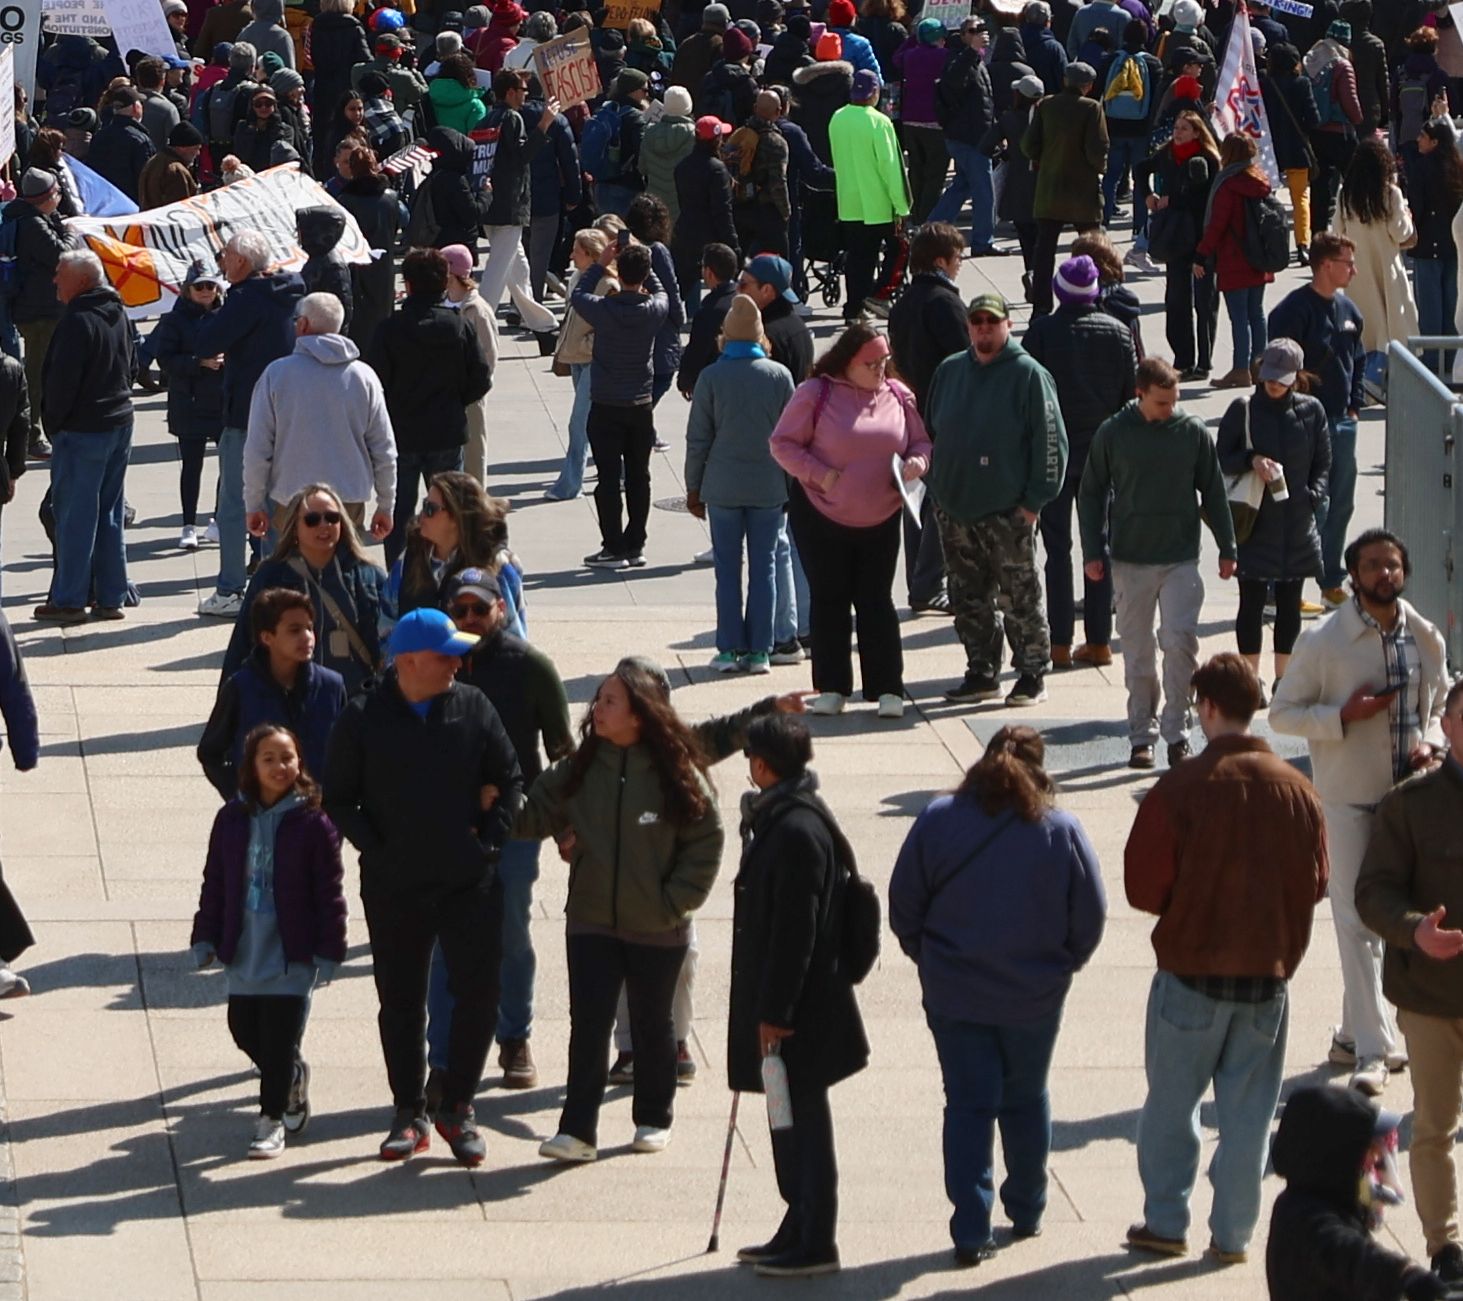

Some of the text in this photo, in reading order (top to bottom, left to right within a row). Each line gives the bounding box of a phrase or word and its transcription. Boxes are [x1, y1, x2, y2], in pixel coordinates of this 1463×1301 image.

[540, 37, 579, 68] REFUSE
[542, 57, 604, 99] FASCISM
[1045, 400, 1059, 484] CARHARTT
